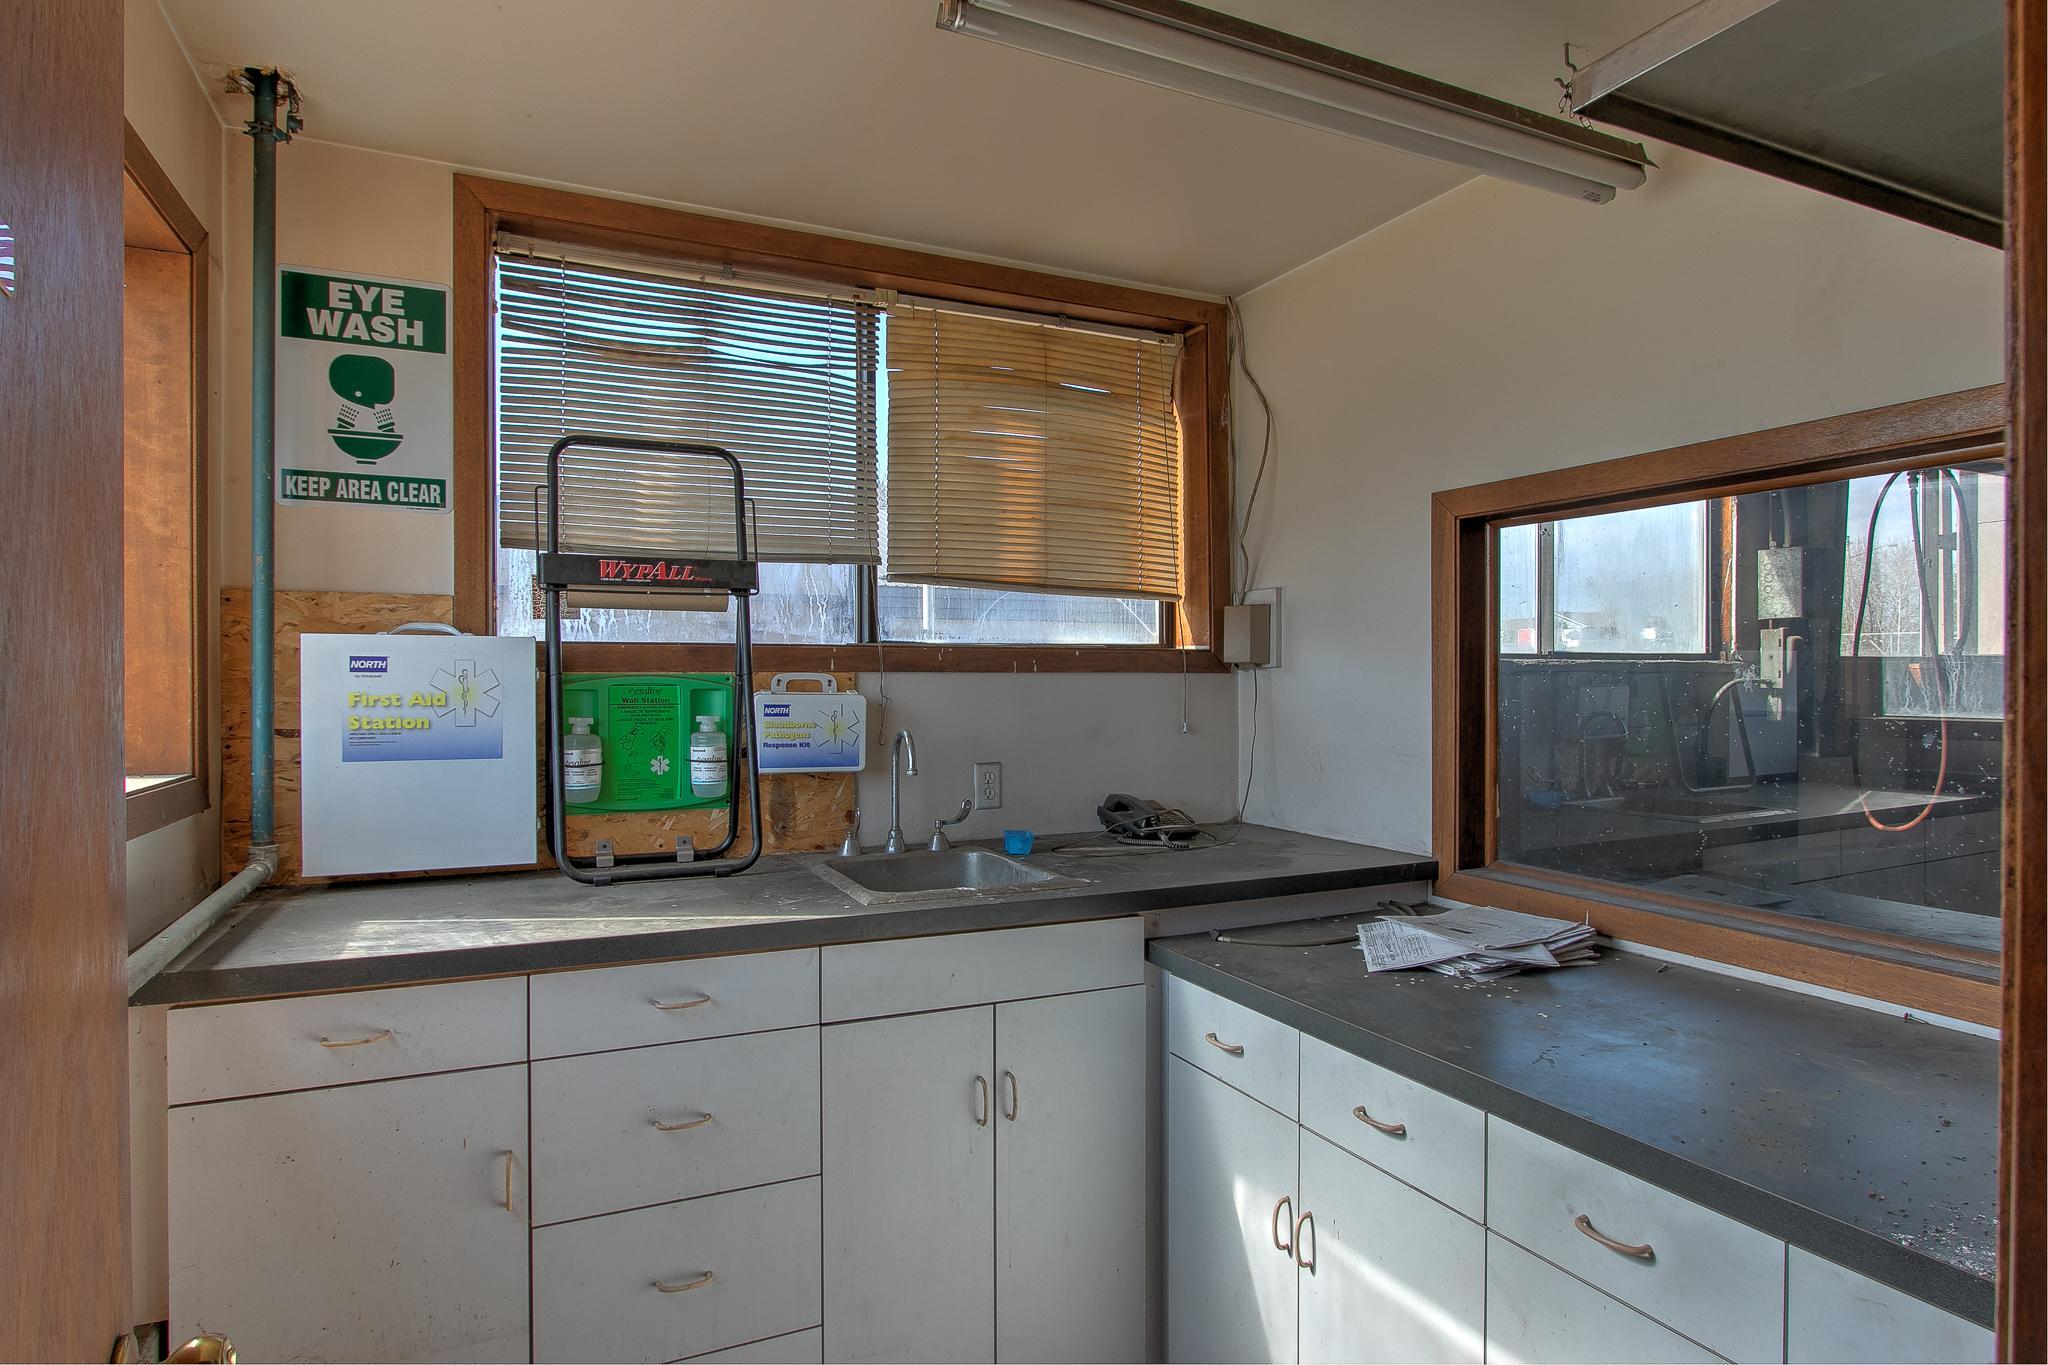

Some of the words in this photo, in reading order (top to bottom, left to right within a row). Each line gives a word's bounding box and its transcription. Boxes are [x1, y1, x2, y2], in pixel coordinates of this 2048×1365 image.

[328, 280, 406, 316] EYE
[306, 307, 424, 347] WASH
[285, 475, 331, 498] KEEP
[336, 479, 383, 501] AREA
[386, 482, 441, 505] CLEAR
[350, 660, 387, 669] NORTH
[348, 691, 401, 707] First
[408, 691, 447, 707] Aid
[348, 714, 431, 731] Station
[763, 720, 817, 729] Bloodborne
[763, 730, 811, 741] Pathogens
